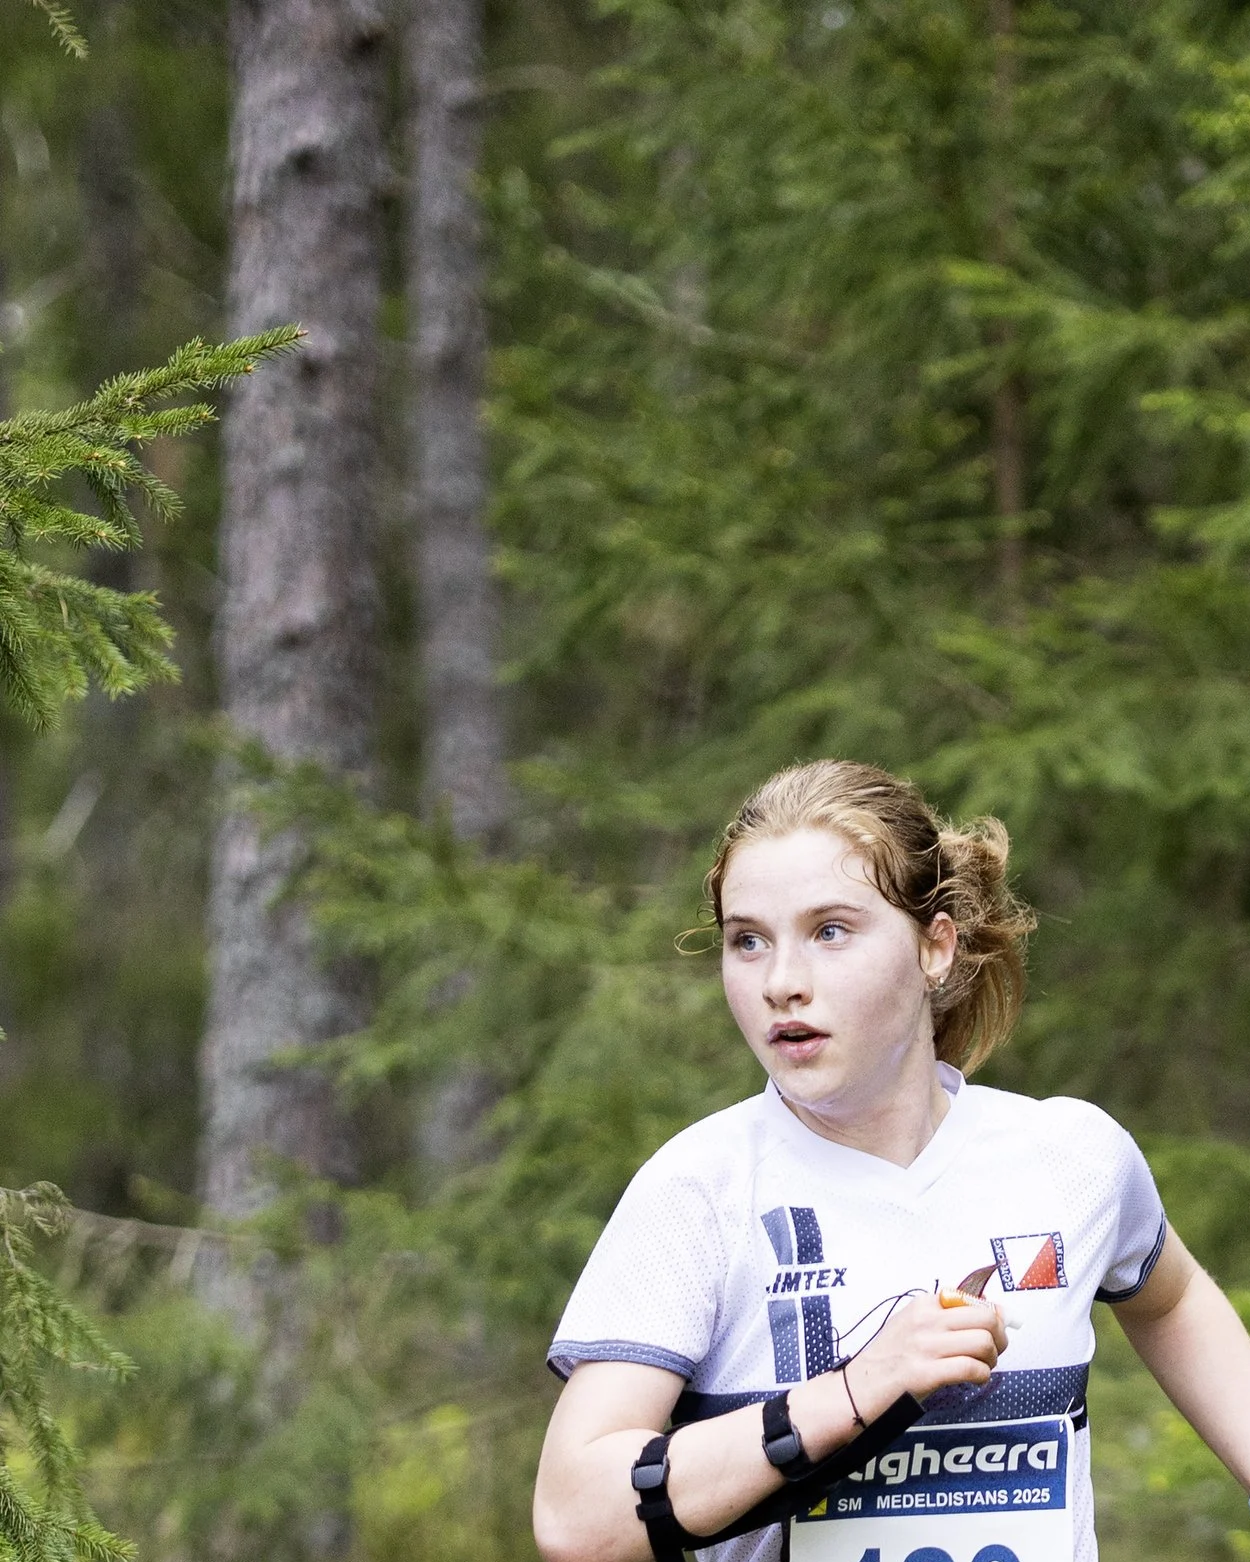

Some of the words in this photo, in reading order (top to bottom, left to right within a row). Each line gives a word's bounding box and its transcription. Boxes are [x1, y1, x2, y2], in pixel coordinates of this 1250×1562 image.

[765, 1267, 848, 1294] IMTEX
[837, 1497, 862, 1512] SM
[876, 1490, 1009, 1510] MEDELDISTANS
[1012, 1487, 1051, 1505] 2025
